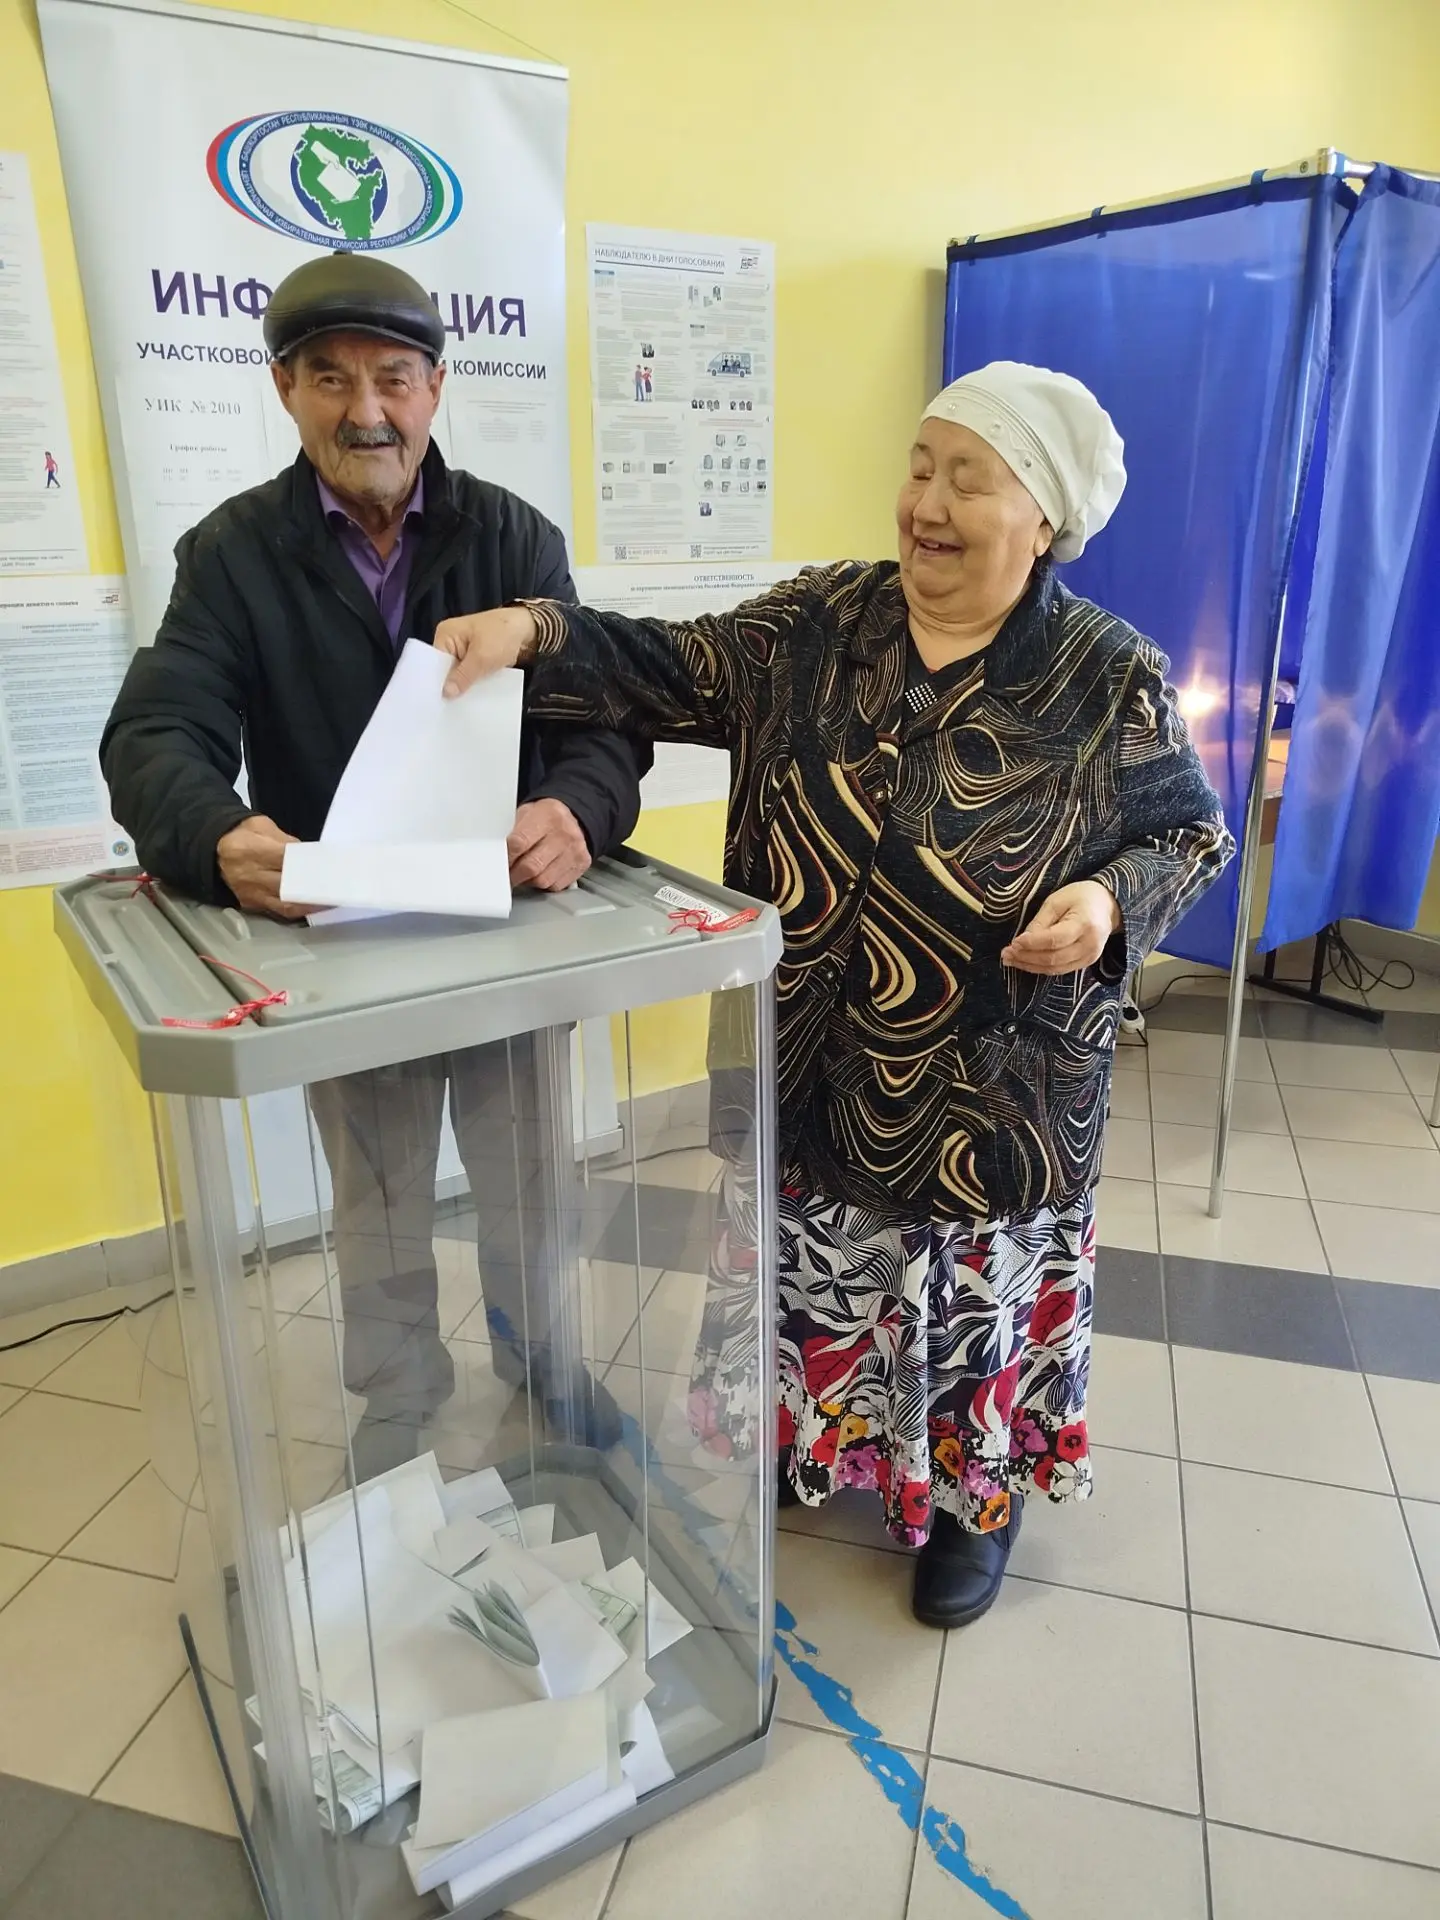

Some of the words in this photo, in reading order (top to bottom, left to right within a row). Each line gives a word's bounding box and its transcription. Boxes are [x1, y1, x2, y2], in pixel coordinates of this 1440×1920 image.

[241, 170, 274, 220] ЦЕНТРАЛЬНАЯ
[275, 216, 330, 246] ИЗБИРАТЕЛЬНАЯ
[332, 240, 369, 250] КОМИССИЯ
[594, 248, 651, 261] НАБЛЮДАТЕЛЮ
[658, 256, 675, 264] ДНИ
[676, 257, 725, 269] ГОЛОСОВАНИЯ
[453, 359, 547, 380] КОМИССИИ
[145, 397, 182, 412] УИК
[693, 573, 755, 582] ОТВЕТСТВЕННОСТЬ
